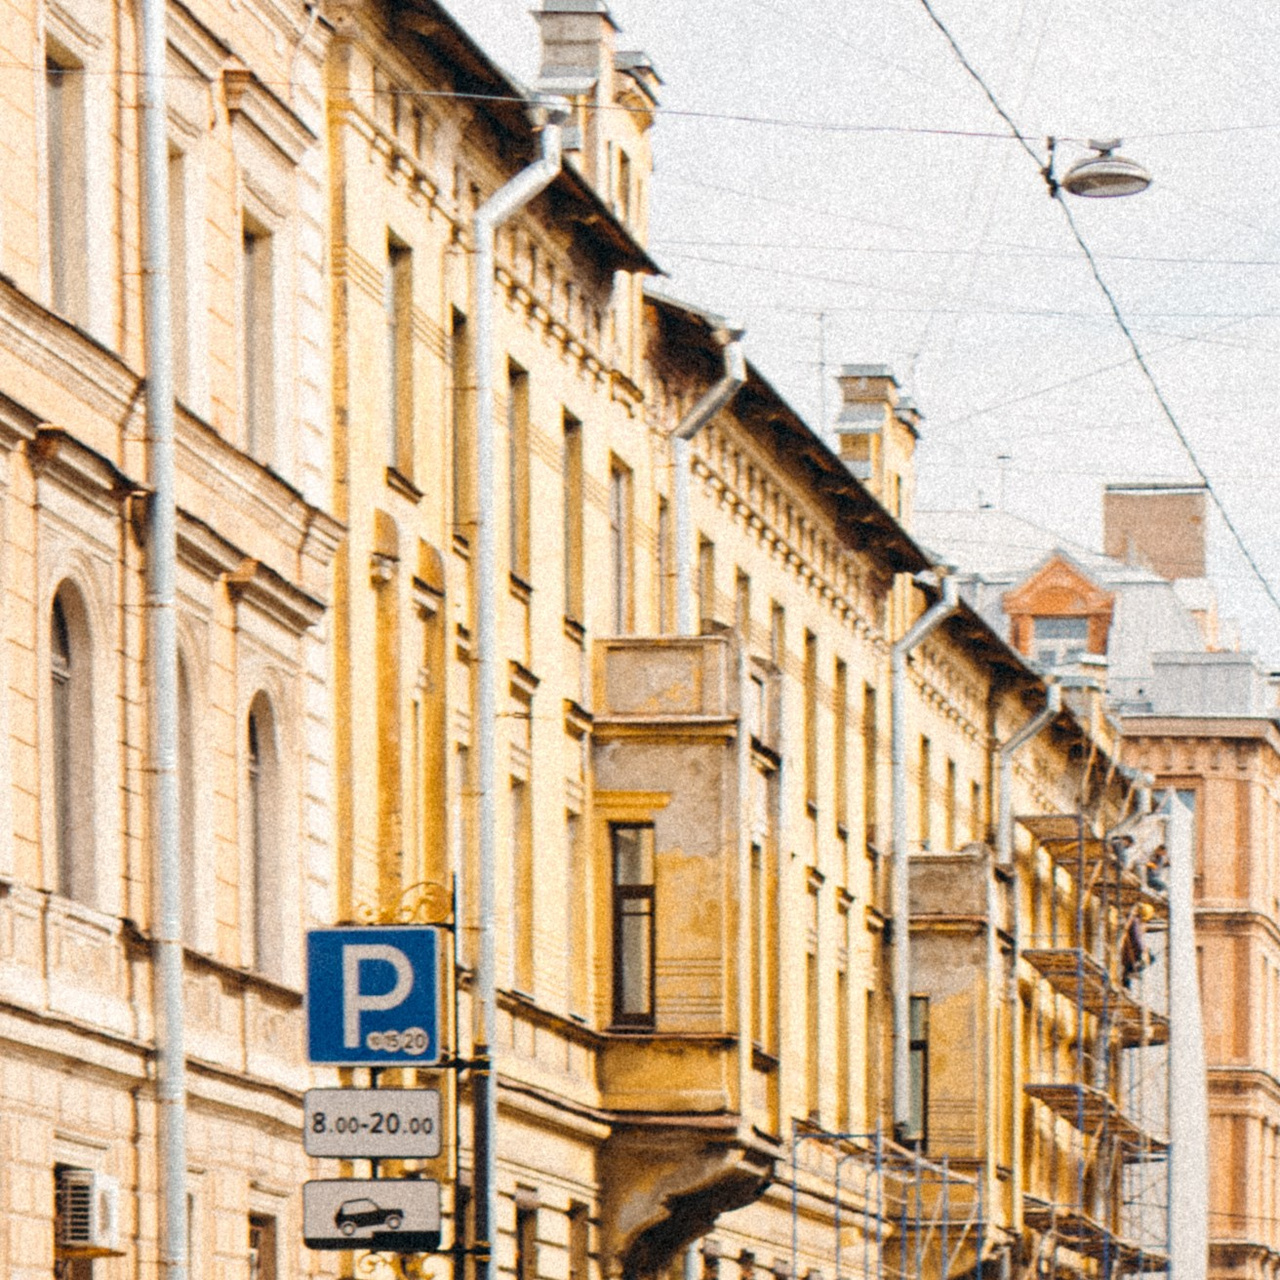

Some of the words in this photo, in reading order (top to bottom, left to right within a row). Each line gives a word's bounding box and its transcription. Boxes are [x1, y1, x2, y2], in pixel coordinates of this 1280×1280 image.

[343, 944, 413, 1048] P
[404, 1034, 425, 1048] 20
[312, 1111, 433, 1135] 8.00-20.00
